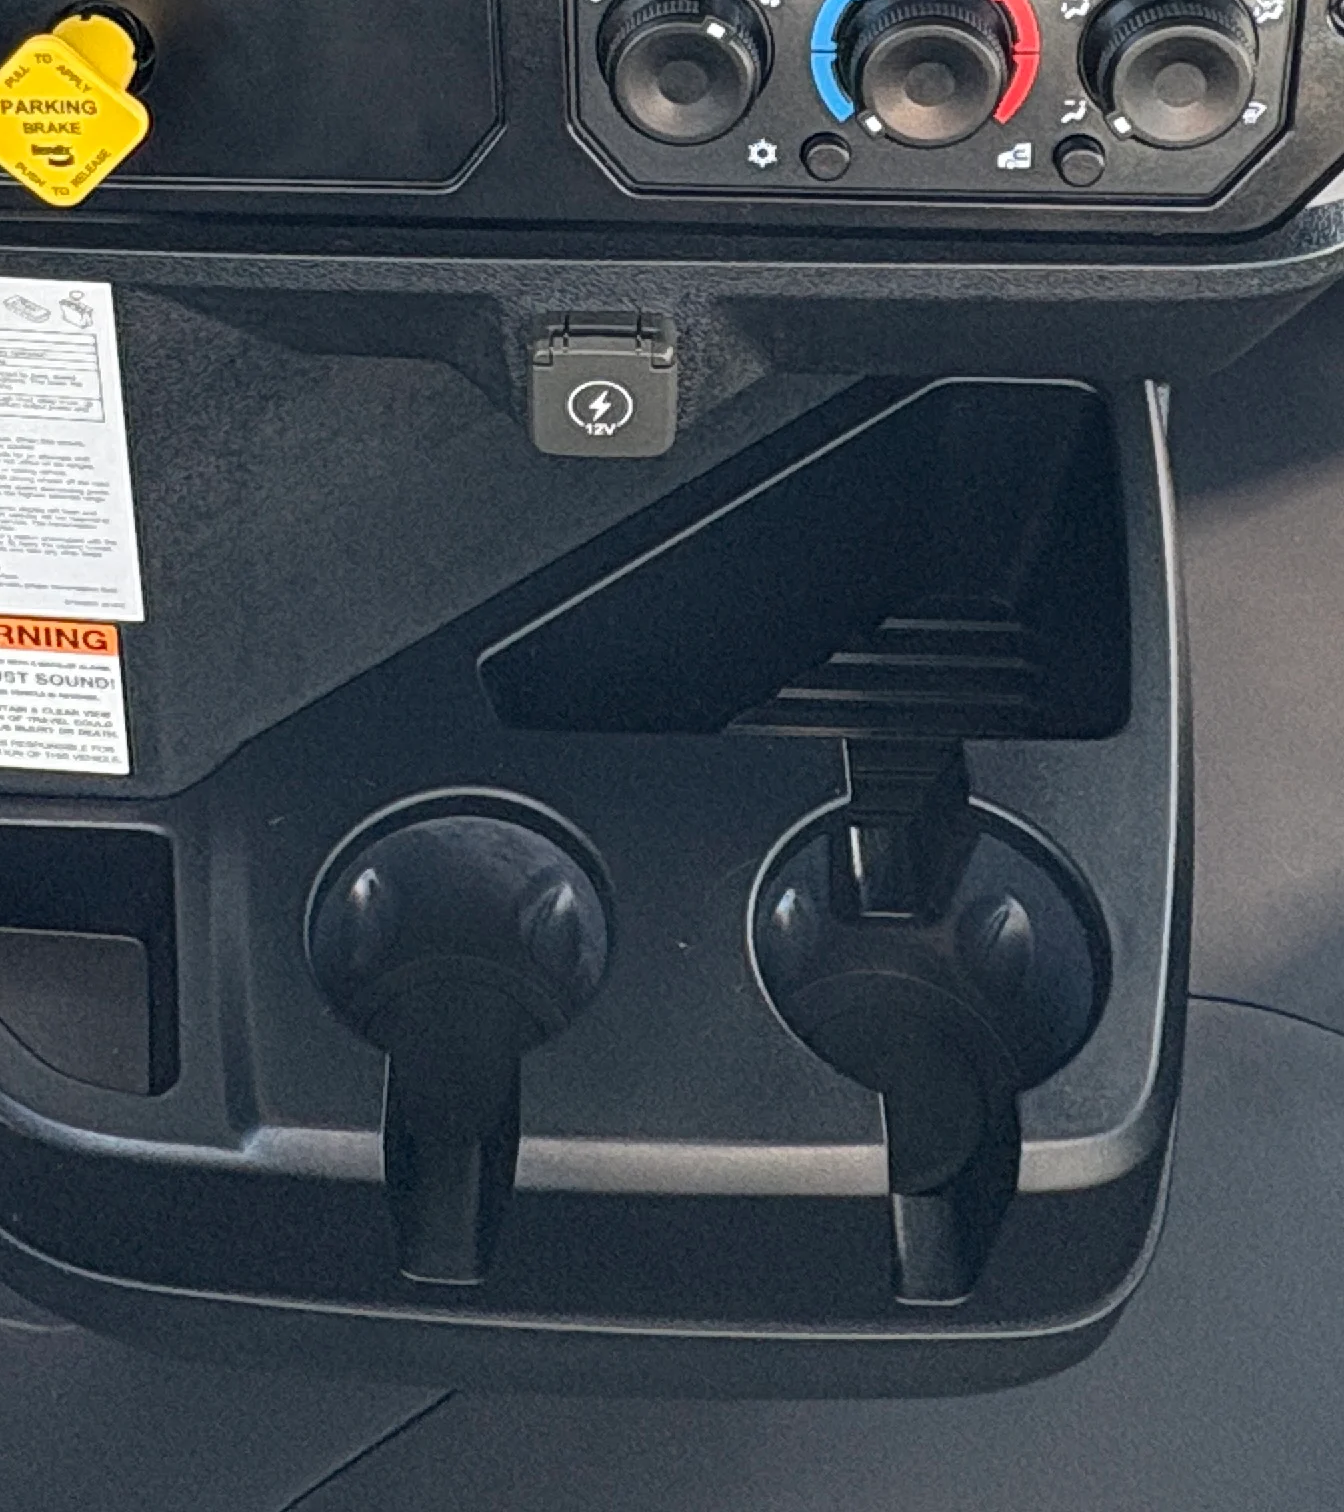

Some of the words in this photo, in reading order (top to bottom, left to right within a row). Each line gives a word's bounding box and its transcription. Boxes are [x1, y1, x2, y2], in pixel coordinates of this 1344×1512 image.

[5, 64, 31, 89] PULL
[34, 53, 53, 64] TO
[56, 64, 93, 94] APPLY
[0, 98, 98, 115] PARKING
[22, 122, 82, 135] BRAKE
[14, 161, 46, 187] PUSH
[51, 187, 70, 196] TO
[70, 147, 113, 188] RELEASE
[585, 423, 616, 436] 12V
[35, 672, 116, 690] SOUND!
